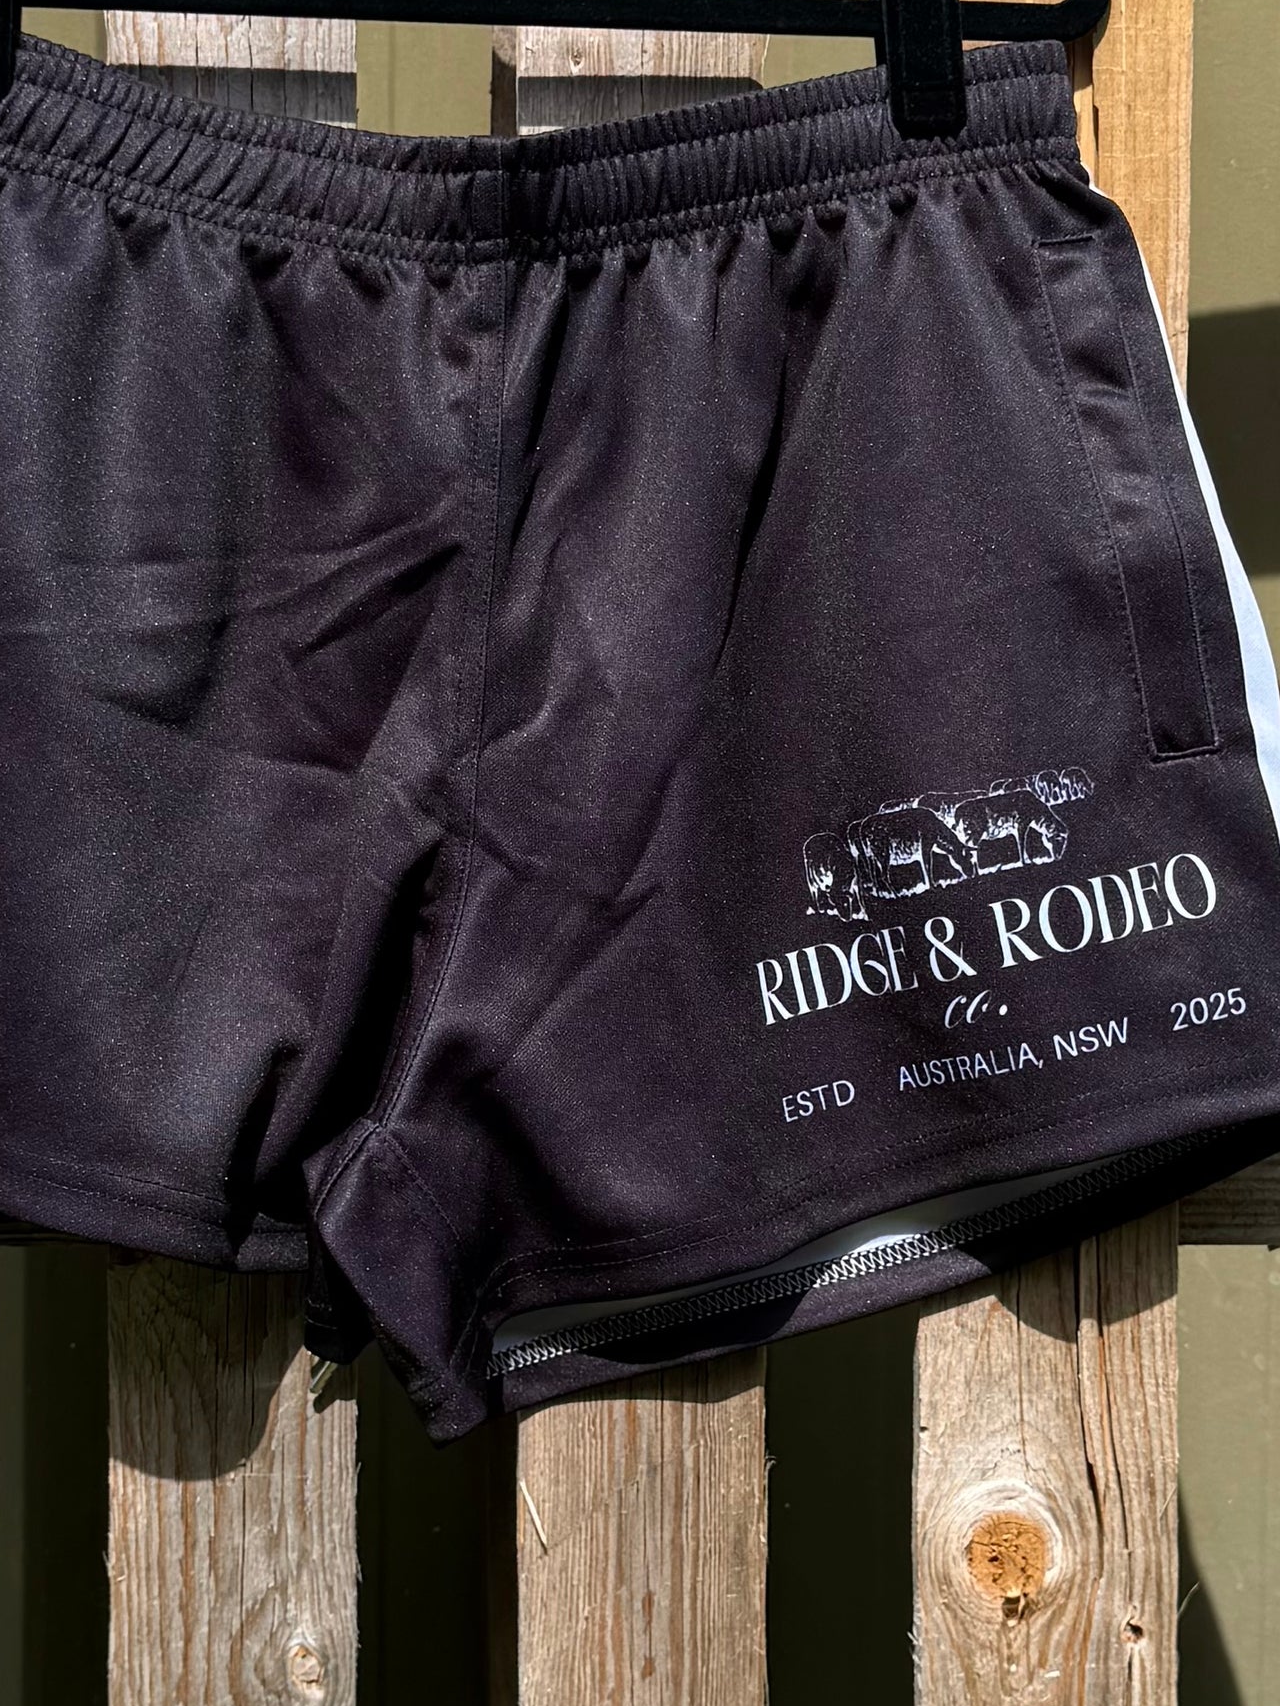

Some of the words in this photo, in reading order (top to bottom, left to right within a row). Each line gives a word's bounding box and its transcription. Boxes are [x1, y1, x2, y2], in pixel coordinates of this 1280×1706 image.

[756, 926, 919, 1025] RIDGE
[925, 917, 977, 982] &
[989, 852, 1217, 968] RODEO
[782, 1080, 856, 1122] ESTD
[899, 1042, 1044, 1090] AUSTRALIA,
[1053, 1017, 1128, 1060] NSW
[1171, 987, 1247, 1031] 2025
